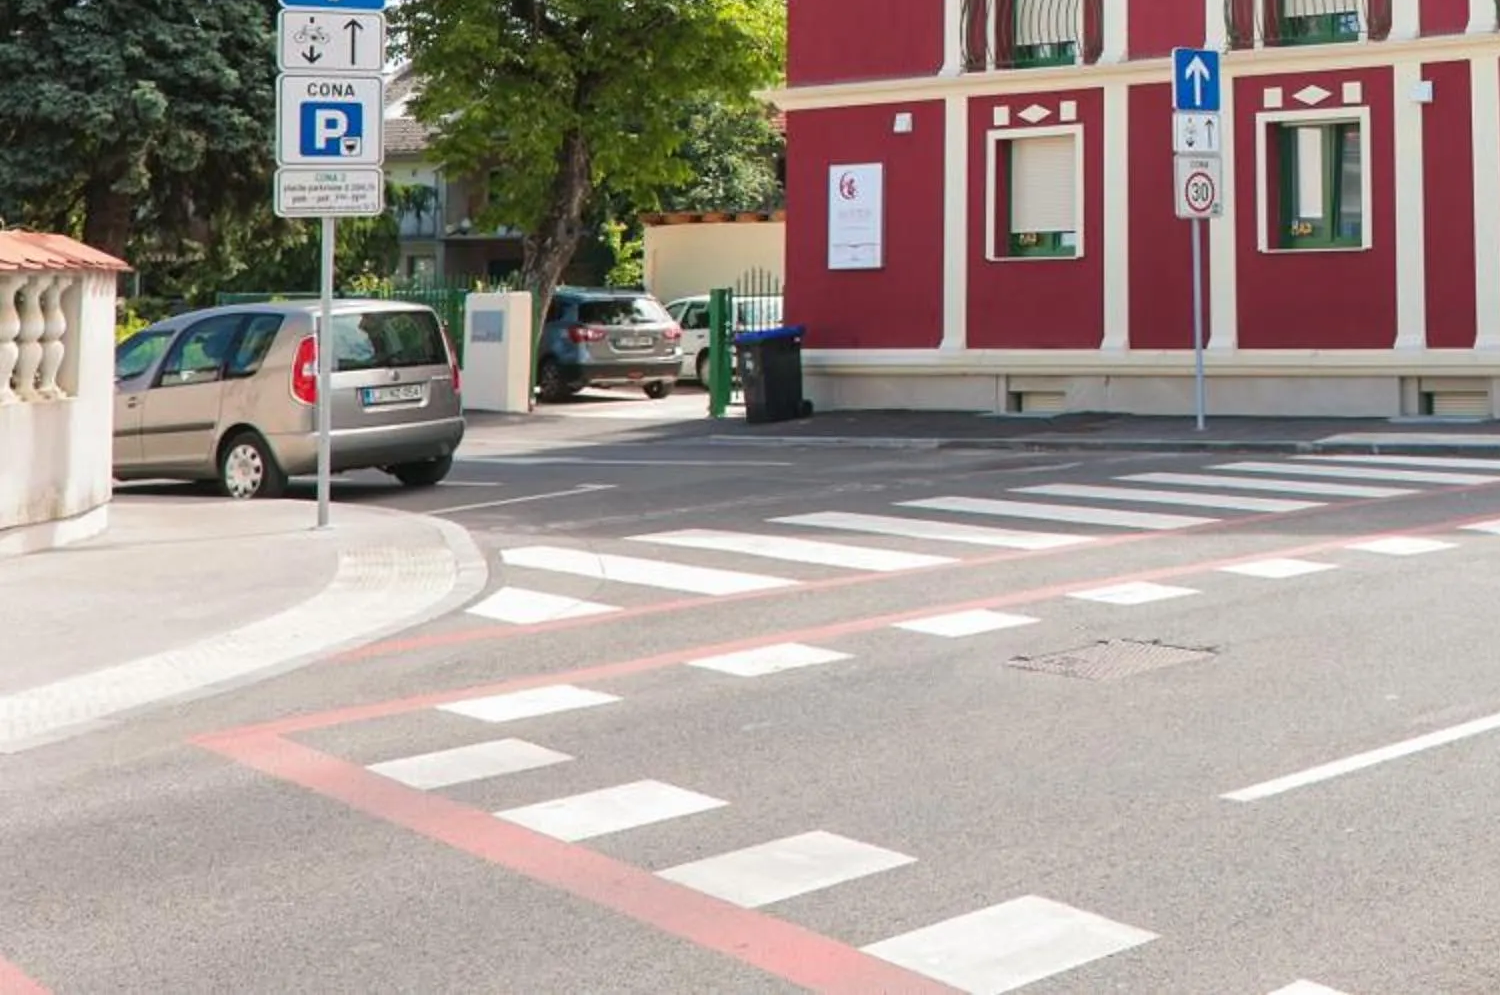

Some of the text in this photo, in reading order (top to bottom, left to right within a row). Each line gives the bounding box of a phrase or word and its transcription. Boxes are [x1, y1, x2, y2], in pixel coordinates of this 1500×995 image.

[307, 82, 355, 97] CONA
[315, 108, 348, 150] P
[1192, 182, 1209, 202] 30
